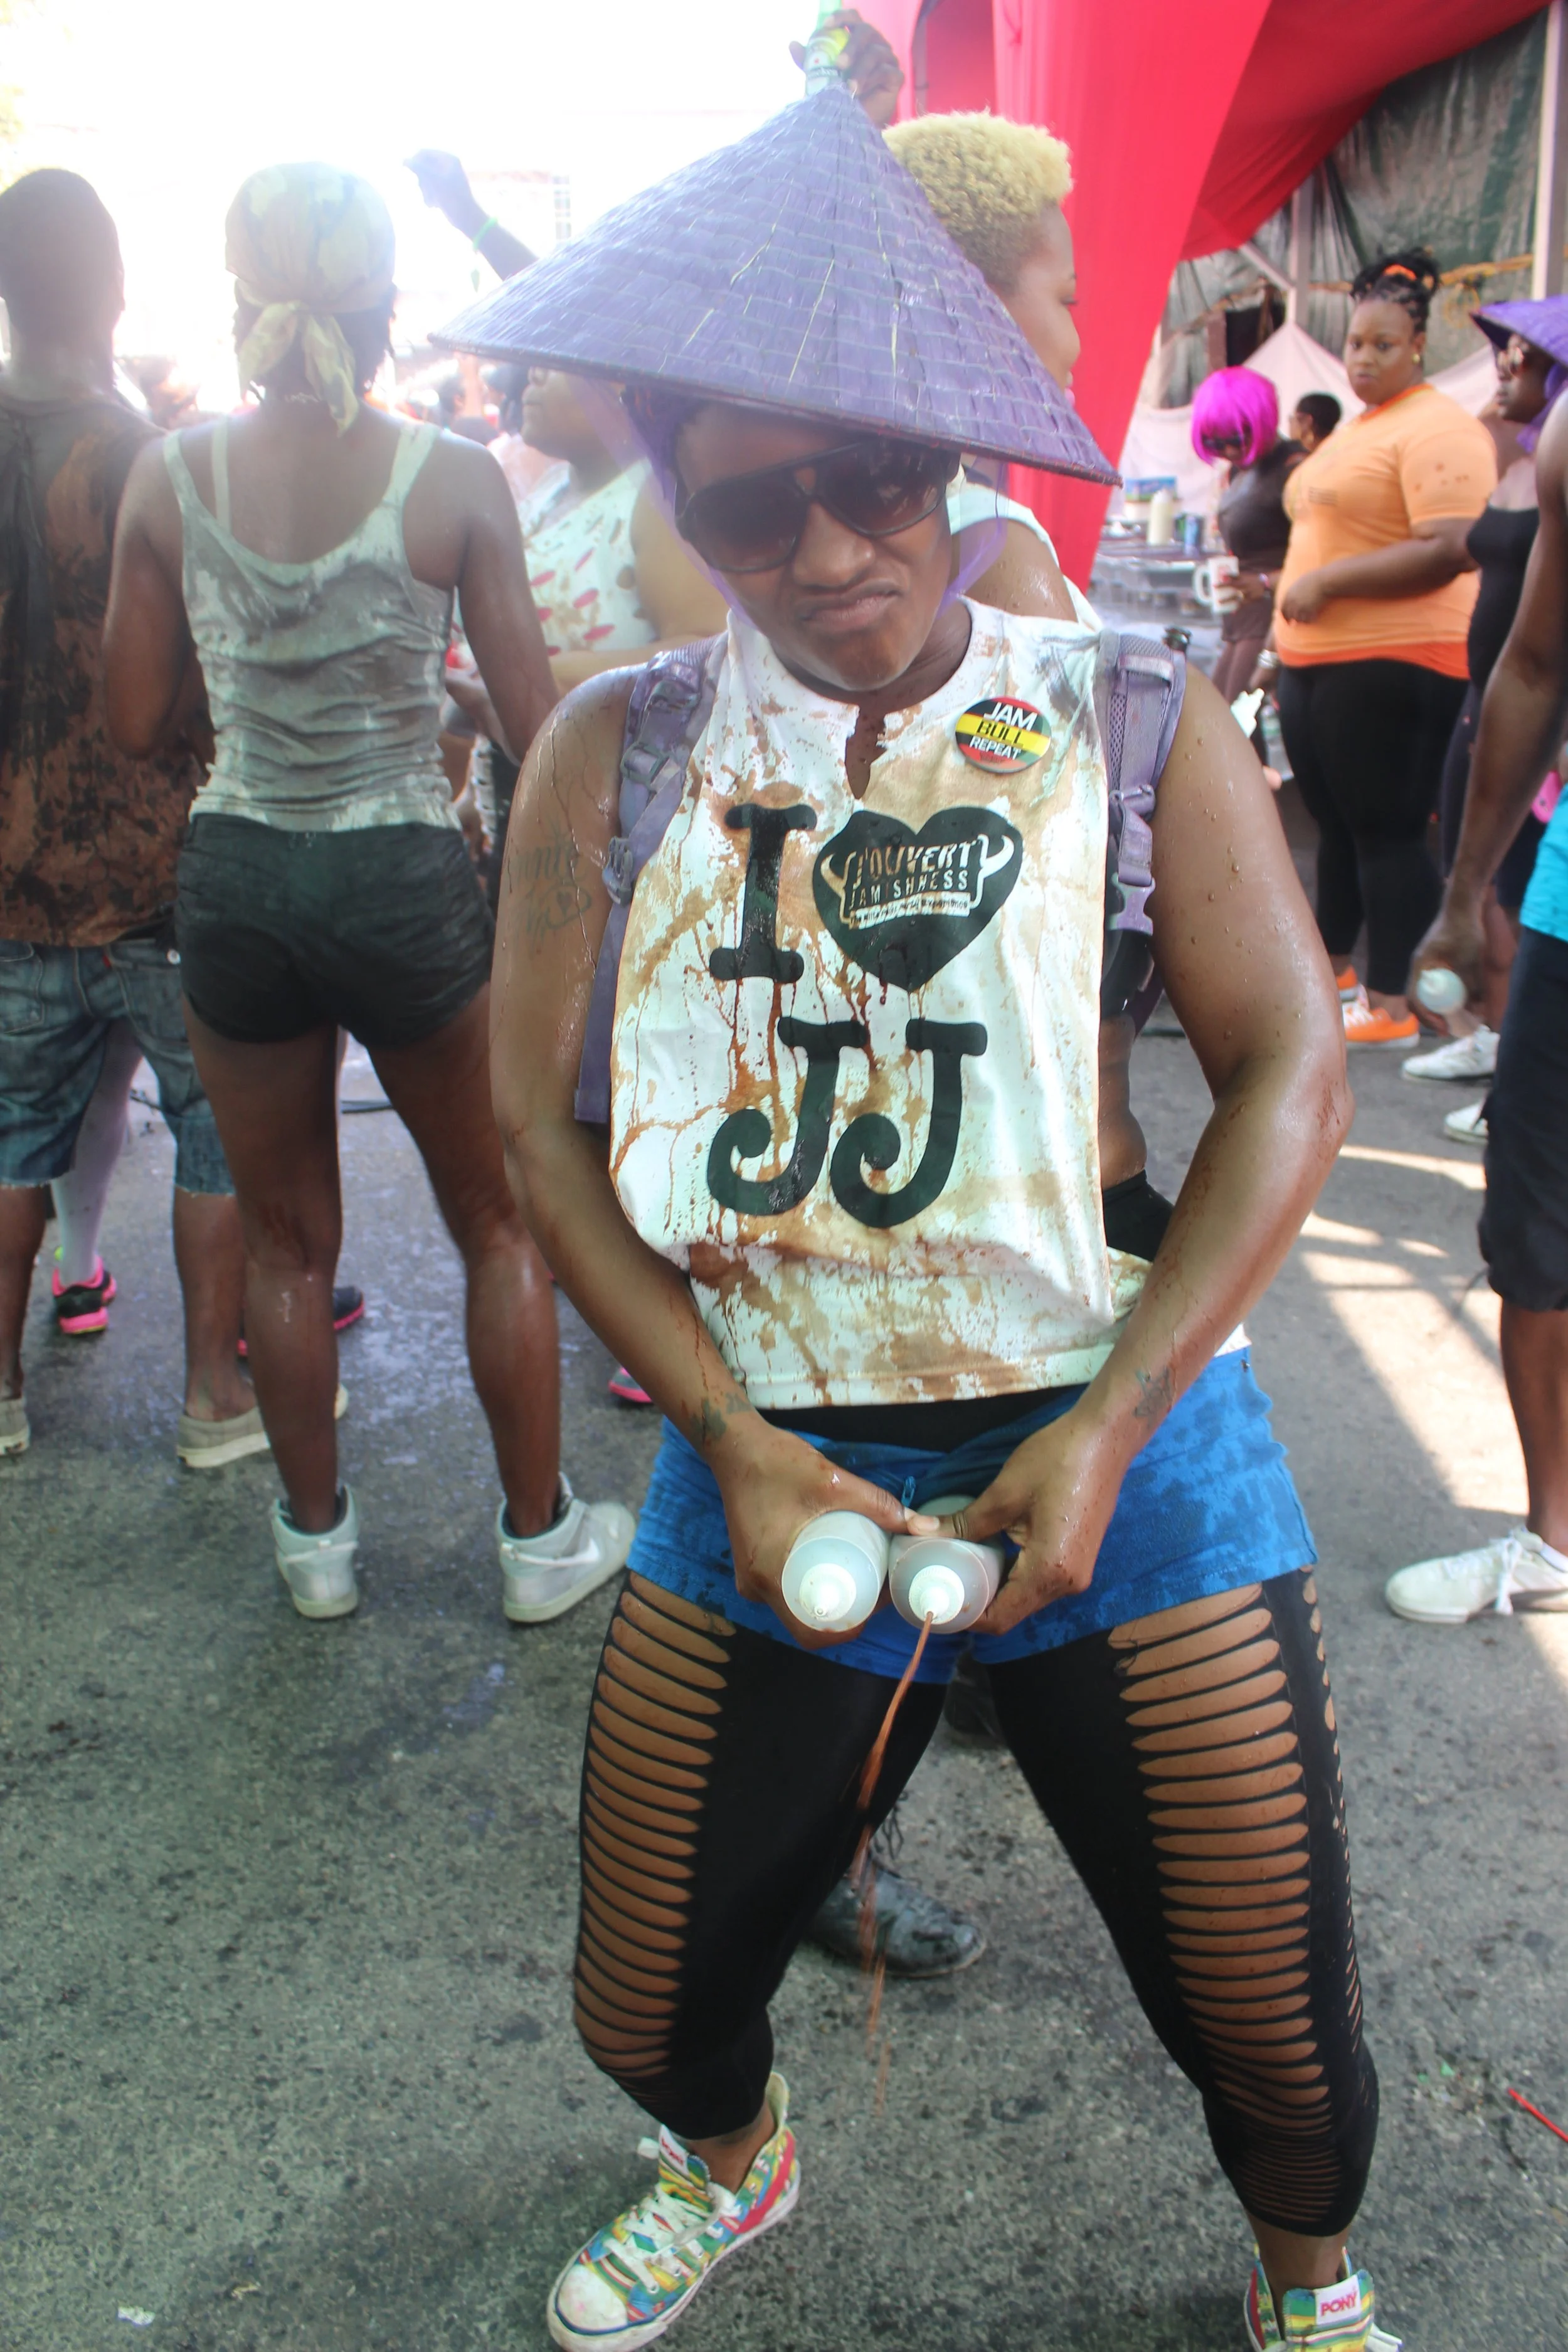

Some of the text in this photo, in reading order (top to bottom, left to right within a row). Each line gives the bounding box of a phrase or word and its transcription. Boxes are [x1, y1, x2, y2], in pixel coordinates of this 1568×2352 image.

[983, 702, 1038, 731] JAM
[976, 721, 1024, 746] BULL
[969, 736, 1022, 761] REPEAT
[709, 803, 817, 982] I
[707, 1015, 987, 1228] JJ
[1320, 2291, 1357, 2316] PONY
